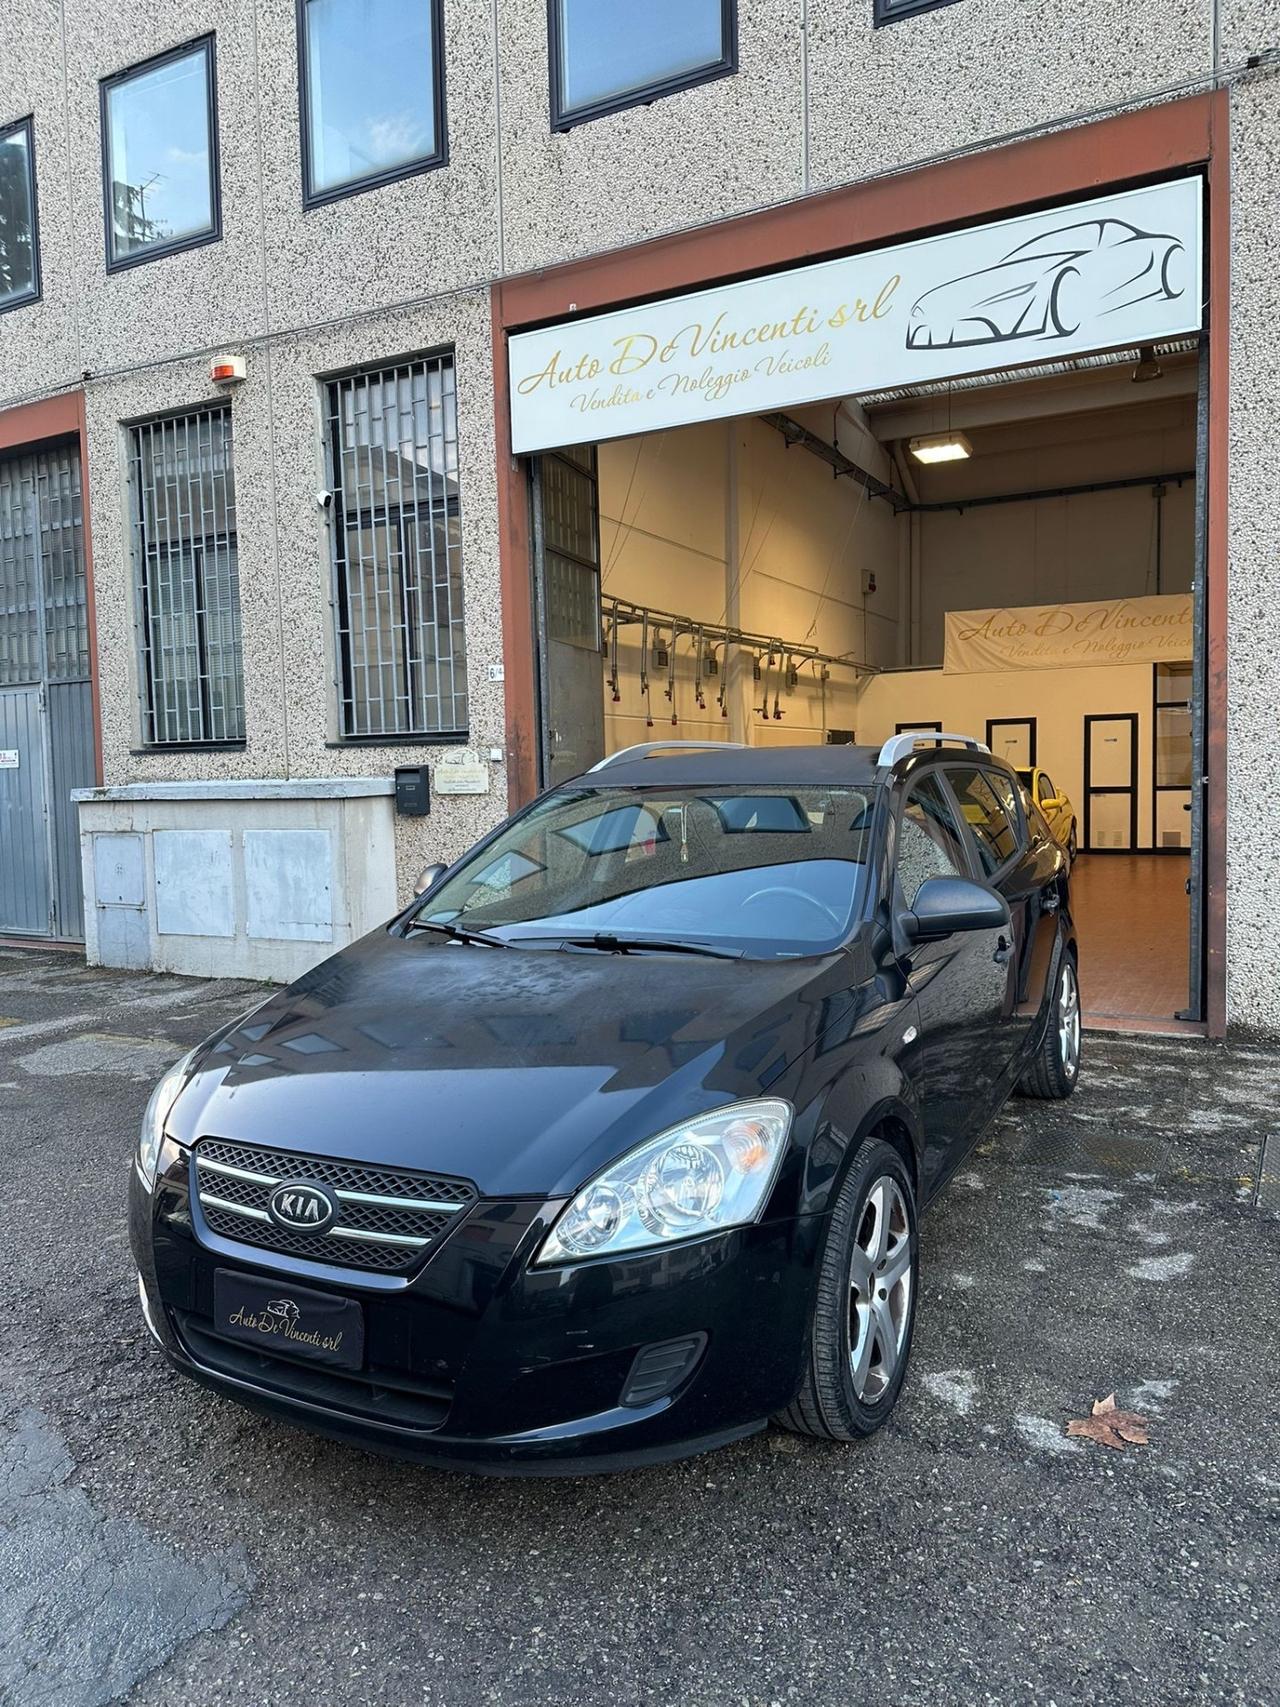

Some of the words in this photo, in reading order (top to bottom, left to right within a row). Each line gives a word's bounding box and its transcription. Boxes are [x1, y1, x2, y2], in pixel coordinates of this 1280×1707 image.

[517, 350, 604, 395] Auto
[828, 274, 901, 329] srl
[570, 384, 643, 412] Vendita
[647, 389, 656, 400] e
[657, 366, 752, 401] Noleggio
[754, 342, 832, 376] Veicoli
[958, 614, 1027, 641] Auto
[1149, 632, 1192, 648] Veico
[281, 1193, 319, 1221] KIA
[229, 1306, 257, 1327] Auto
[322, 1332, 343, 1351] srl
